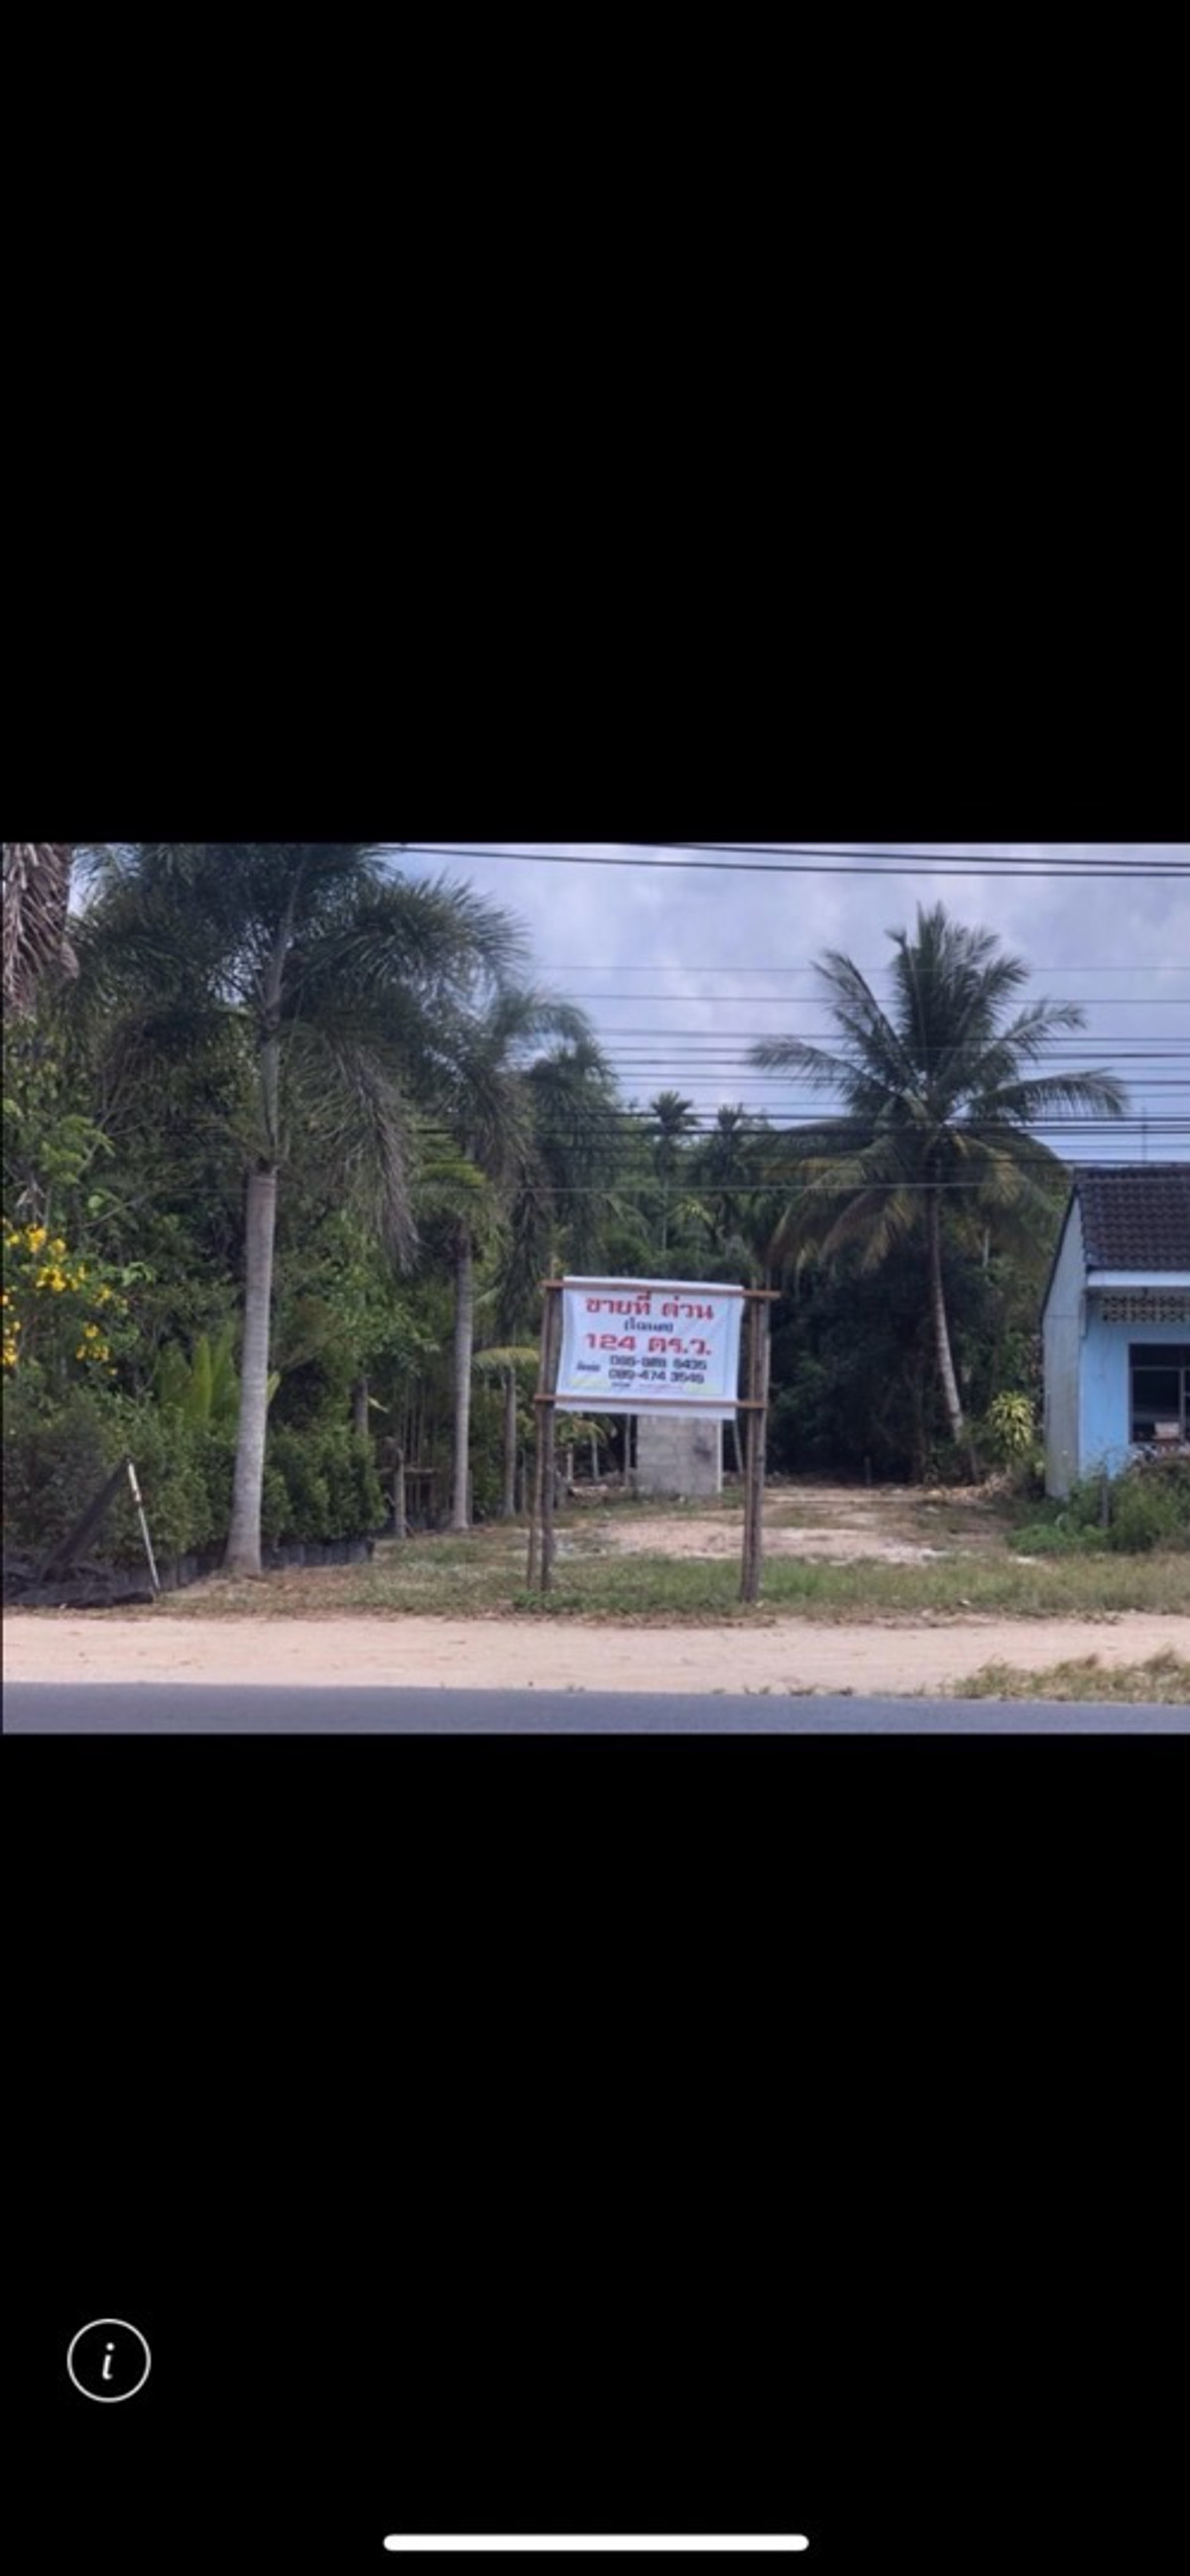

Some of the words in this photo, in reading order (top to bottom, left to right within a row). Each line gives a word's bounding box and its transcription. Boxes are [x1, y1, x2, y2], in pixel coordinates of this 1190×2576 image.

[586, 1291, 652, 1316] ขายที่
[661, 1295, 714, 1320] ด่วน
[586, 1333, 637, 1351] 124
[648, 1336, 712, 1355] ตร.ว.
